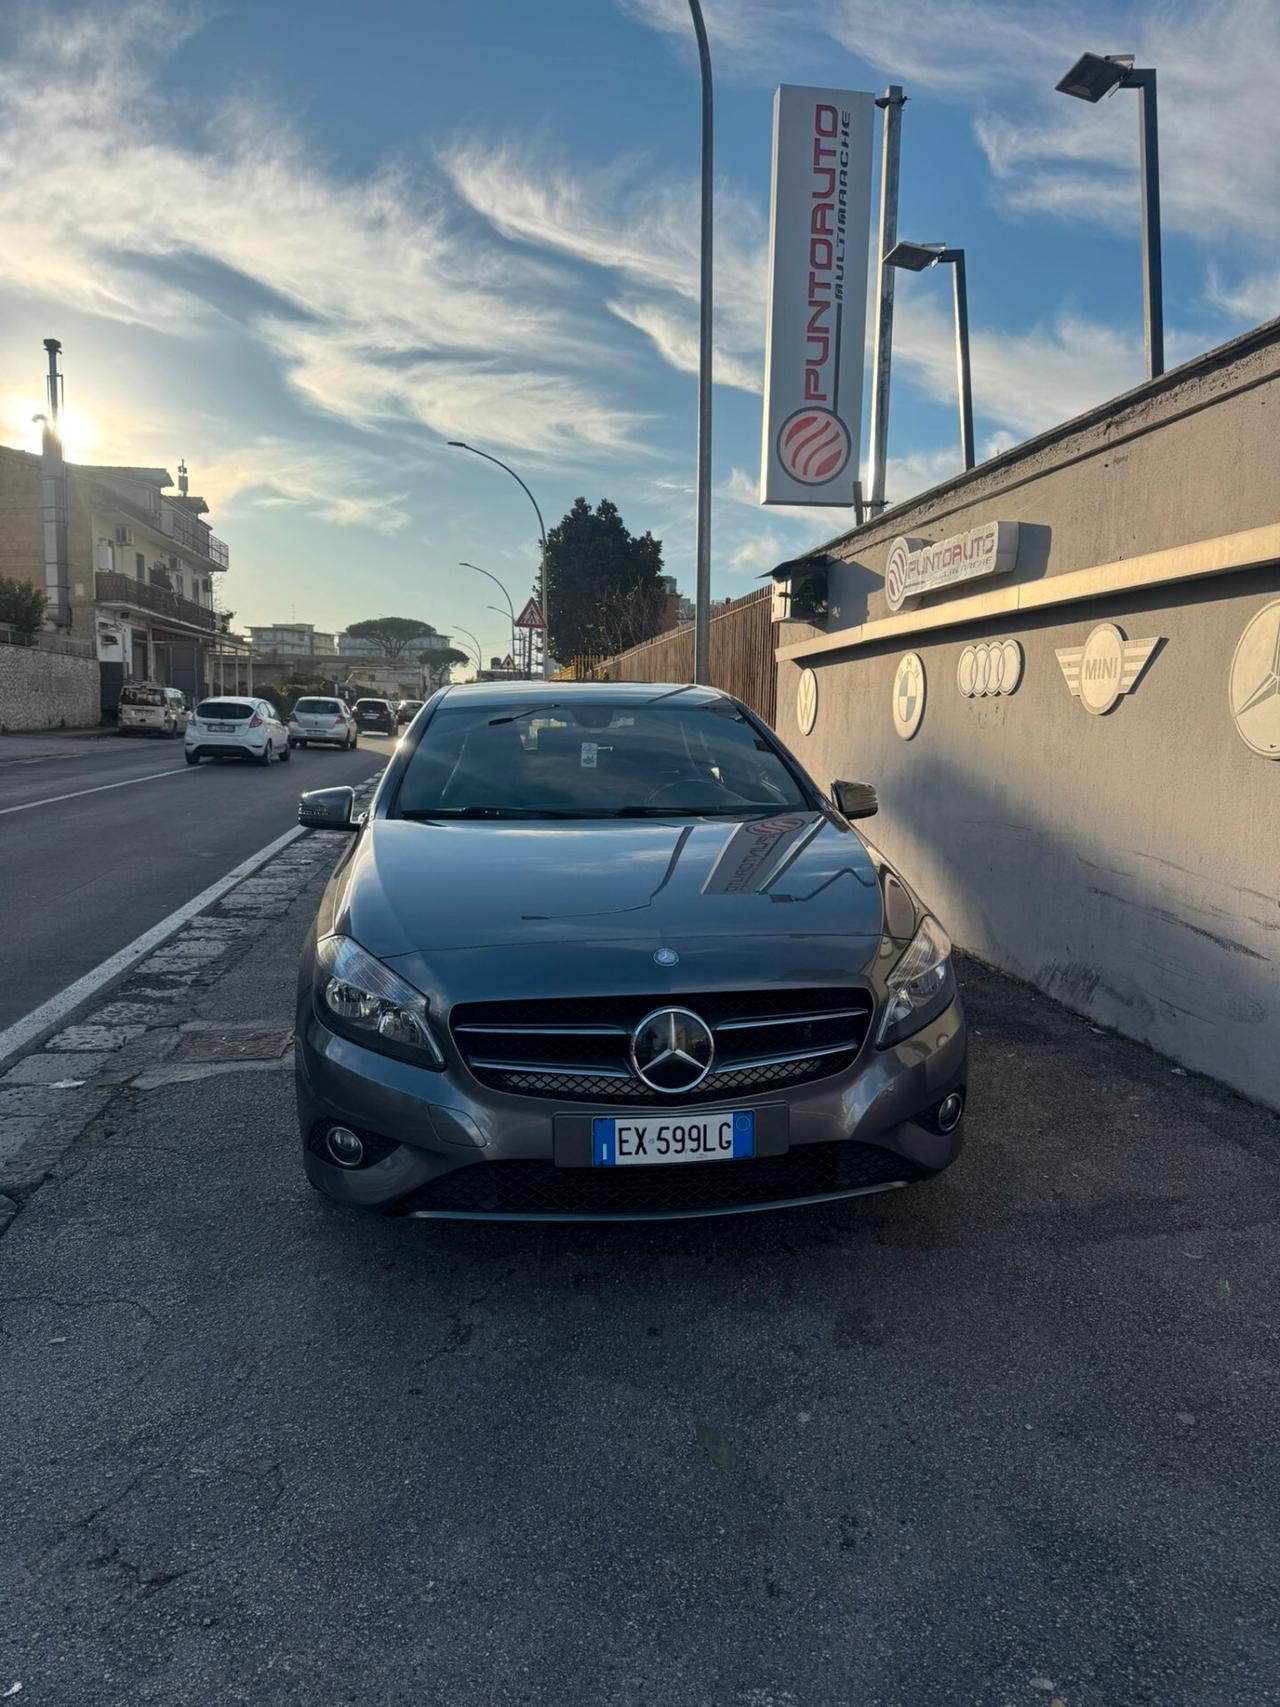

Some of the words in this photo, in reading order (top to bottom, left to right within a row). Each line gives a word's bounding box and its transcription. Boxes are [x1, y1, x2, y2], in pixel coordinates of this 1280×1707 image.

[835, 110, 851, 301] MULTIMARCHE
[804, 103, 839, 401] PUNTOAUTO
[907, 532, 994, 579] PUNTOAUTO
[1084, 656, 1119, 681] MINI
[618, 1127, 648, 1156] EX
[656, 1122, 732, 1155] 599LG
